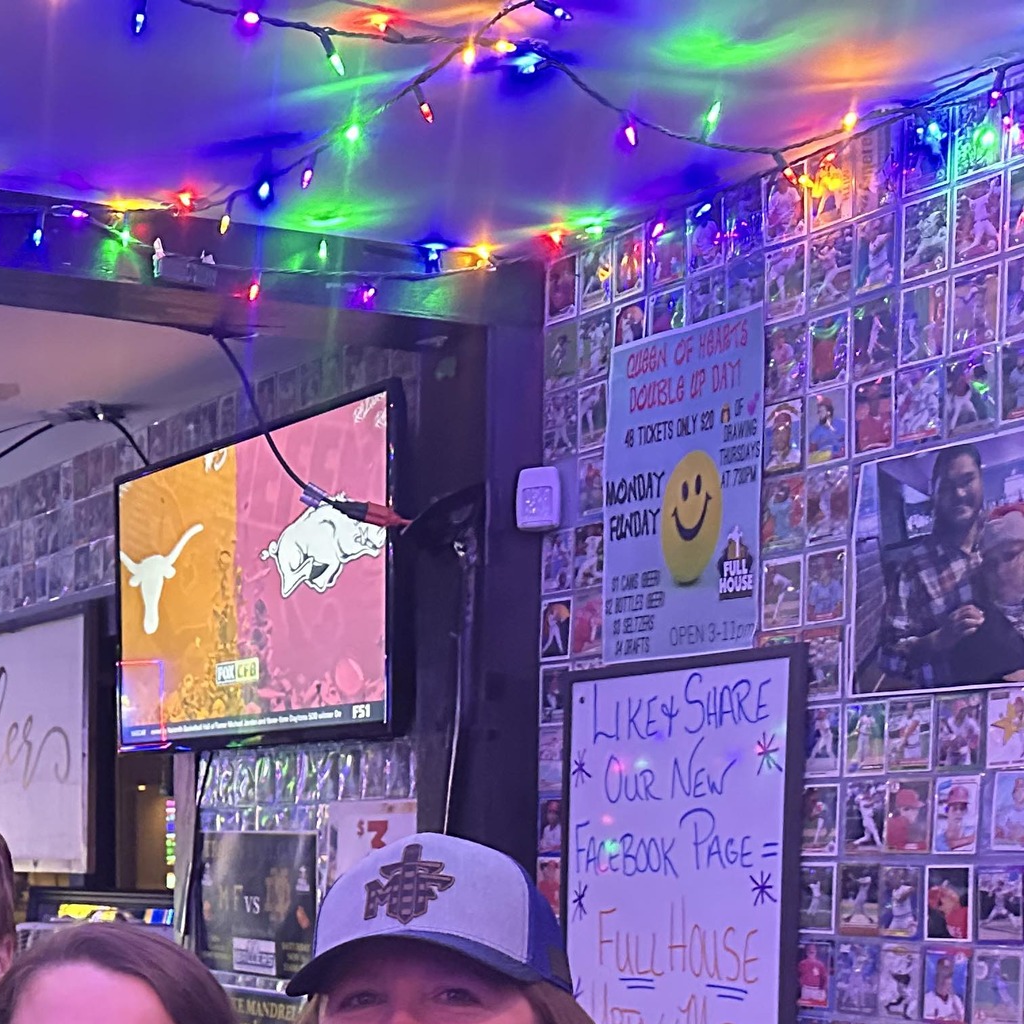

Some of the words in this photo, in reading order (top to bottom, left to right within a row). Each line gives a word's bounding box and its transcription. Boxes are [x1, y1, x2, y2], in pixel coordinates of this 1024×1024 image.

[626, 342, 668, 379] QUEEN
[674, 336, 693, 366] OF
[699, 318, 748, 360] HEARTS
[629, 375, 685, 414] DOUBLE
[690, 368, 707, 399] UP
[624, 428, 635, 448] 48
[638, 420, 674, 446] TICKETS
[676, 413, 699, 437] ONLY
[605, 471, 666, 506] MONDAY
[609, 508, 661, 542] FUNDAY
[719, 573, 753, 594] HOUSE
[723, 558, 749, 577] FULL
[669, 624, 705, 647] OPEN
[217, 663, 236, 682] FOX
[593, 683, 658, 744] LIKE
[684, 672, 772, 734] SHARE
[679, 807, 754, 870] PAGE
[243, 895, 261, 915] VS
[598, 908, 665, 977] FULL
[668, 894, 759, 984] HOUSE
